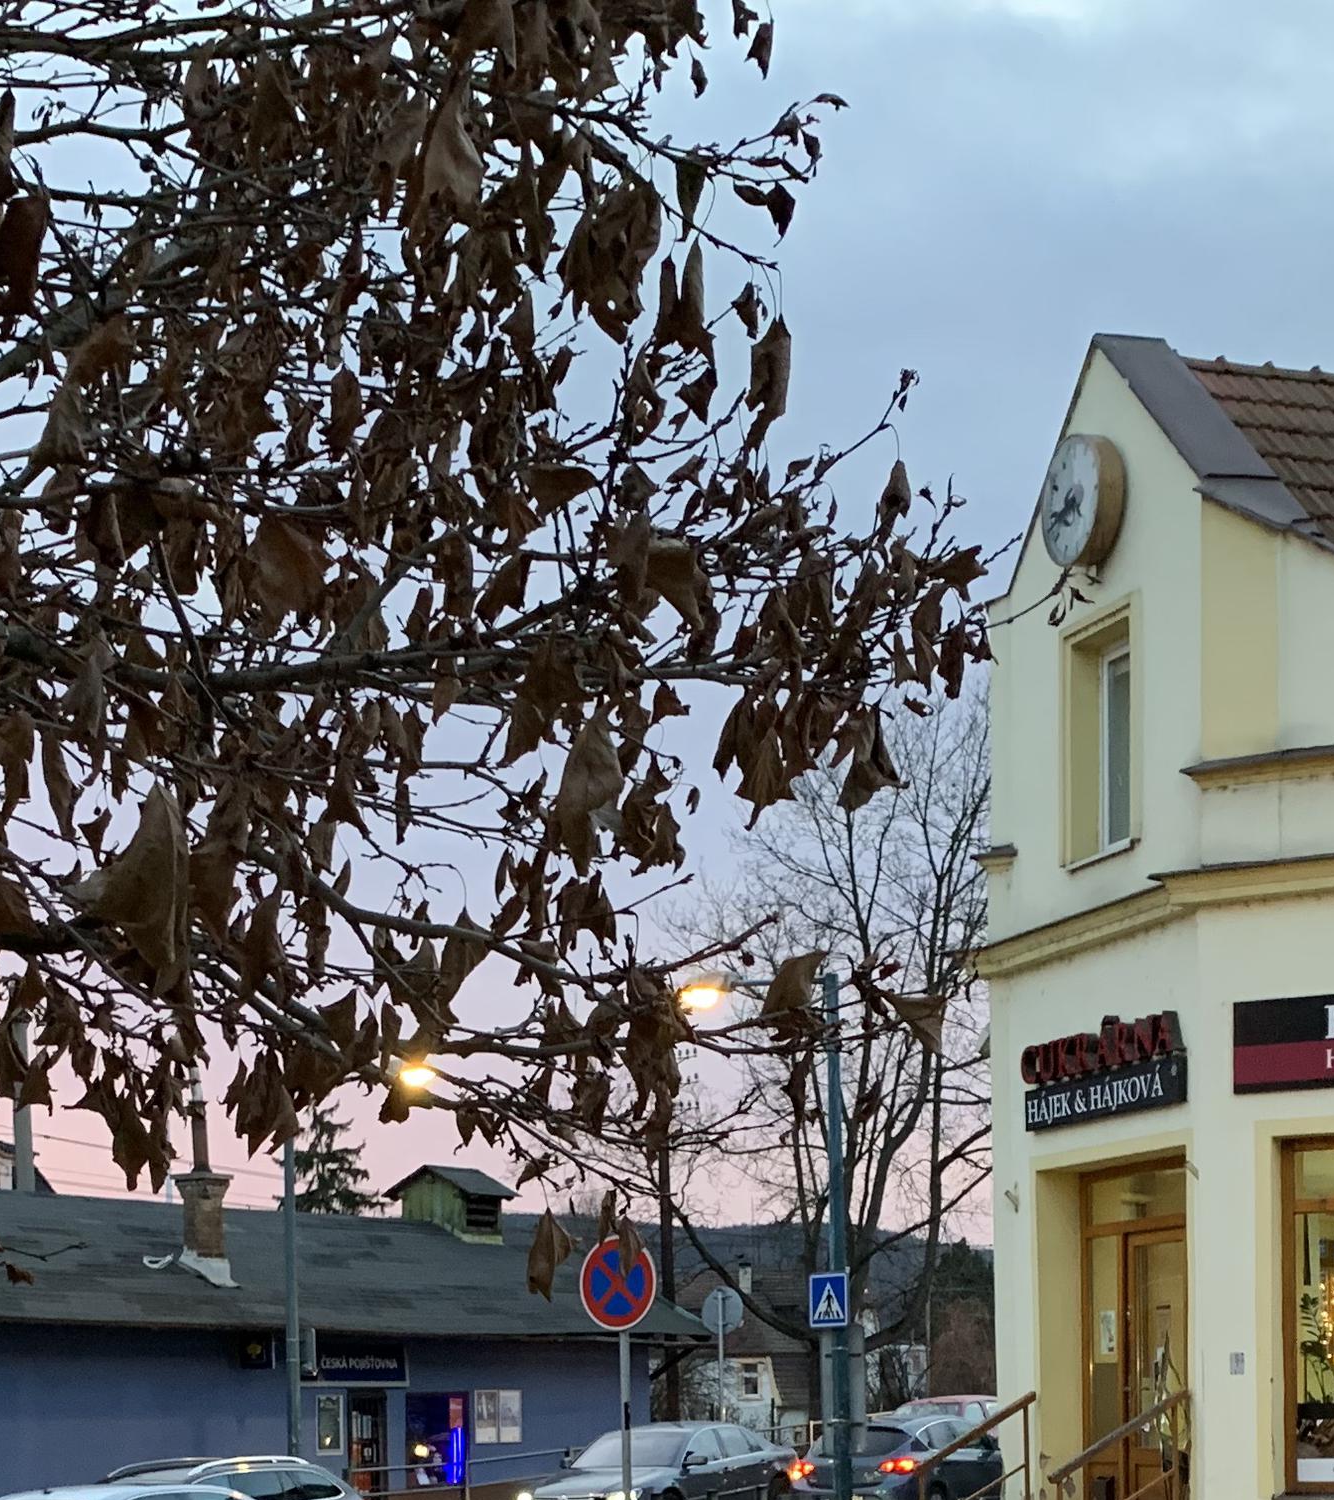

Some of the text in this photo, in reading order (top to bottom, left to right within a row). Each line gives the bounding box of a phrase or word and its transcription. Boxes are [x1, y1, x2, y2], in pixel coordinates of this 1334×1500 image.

[1020, 1010, 1186, 1085] CUKRÁRNA
[1026, 1064, 1164, 1125] HÁJEK & HÁJKOVÁ
[320, 1354, 348, 1370] ČESKÁ
